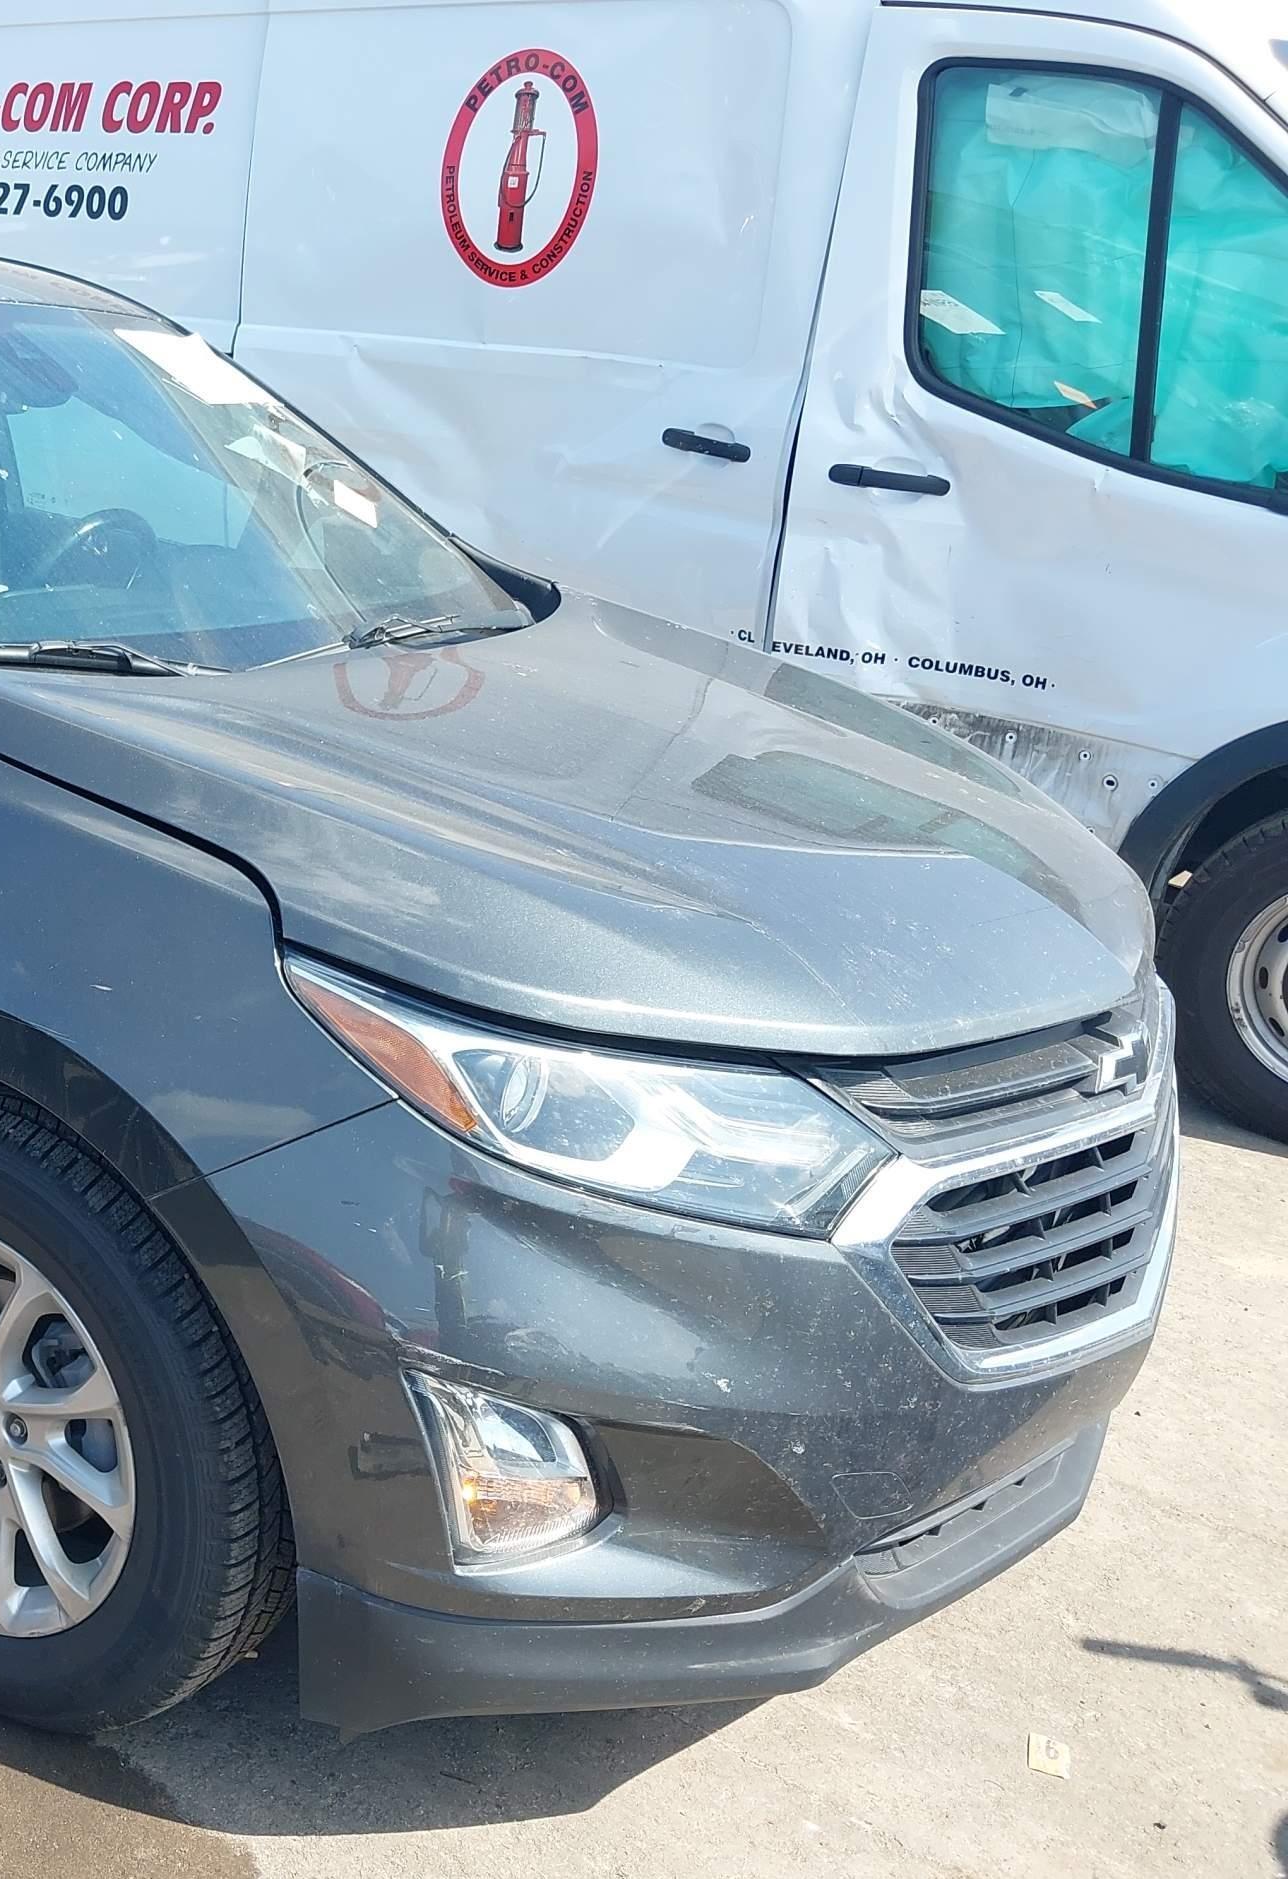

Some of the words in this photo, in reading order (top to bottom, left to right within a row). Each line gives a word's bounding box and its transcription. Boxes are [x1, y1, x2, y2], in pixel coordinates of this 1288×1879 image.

[101, 80, 222, 135] CORP.
[464, 52, 589, 115] PETRO-COM
[1, 151, 71, 171] SERVICE
[75, 152, 159, 174] COMPANY
[445, 165, 471, 253] PETROLEUM
[467, 252, 516, 282] SERVICE
[532, 170, 593, 274] CONSTRUCTION
[861, 651, 886, 666] OH
[907, 655, 1016, 686] COLUMBUS,
